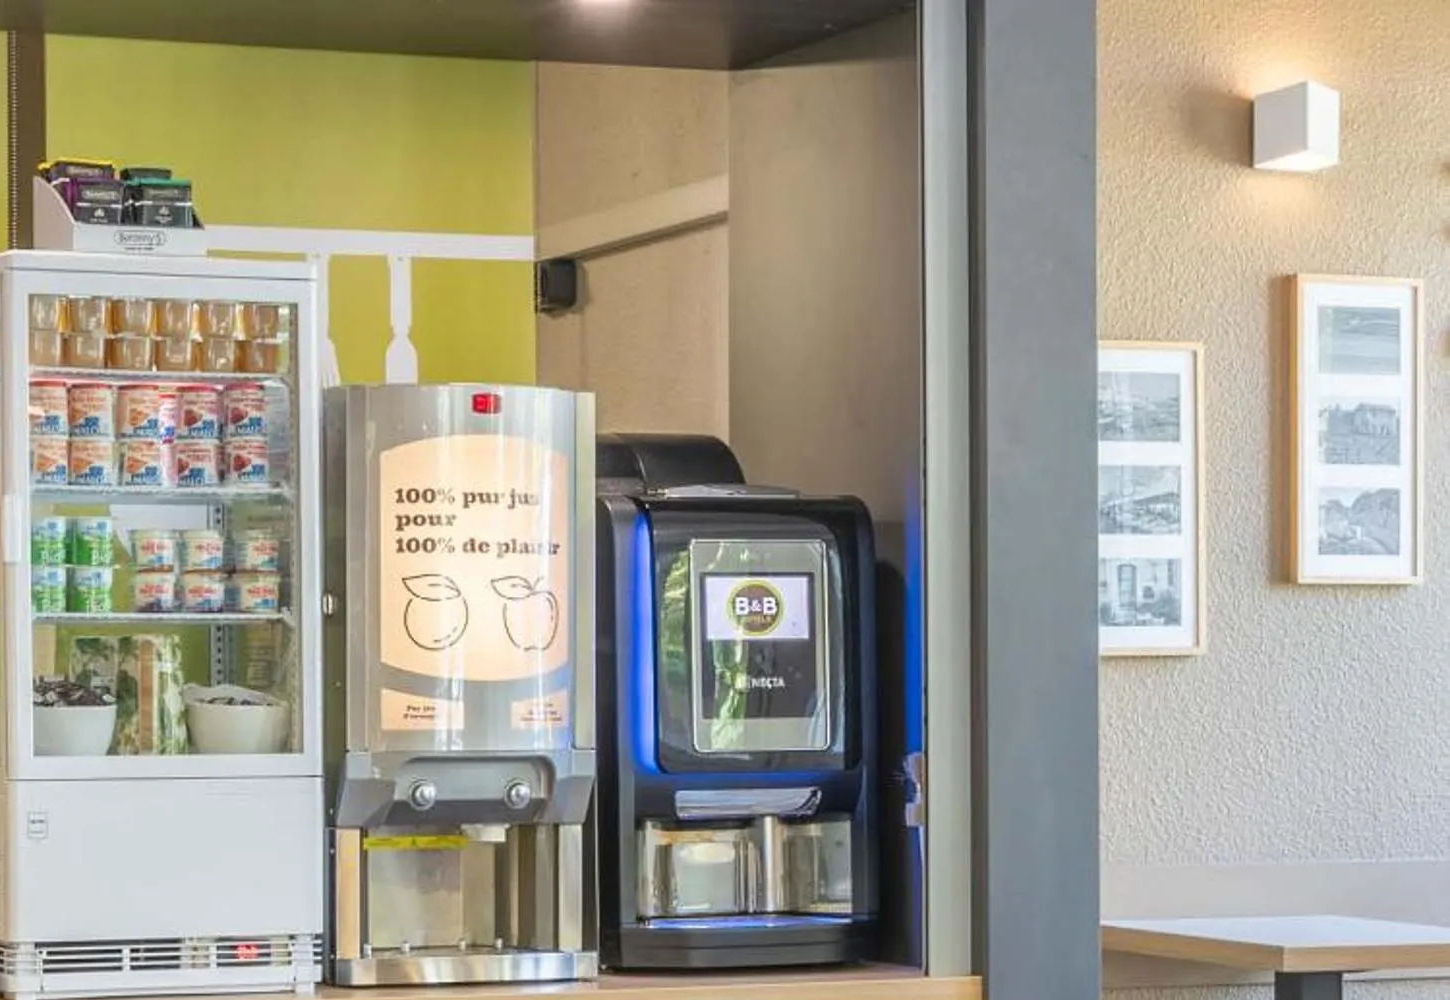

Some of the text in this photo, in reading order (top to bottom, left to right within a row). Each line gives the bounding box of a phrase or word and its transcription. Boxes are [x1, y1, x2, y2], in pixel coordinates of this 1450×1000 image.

[394, 488, 455, 504] 100%
[394, 514, 457, 531] pour
[395, 537, 455, 553] 100%
[462, 538, 490, 553] de
[735, 597, 777, 615] B&B
